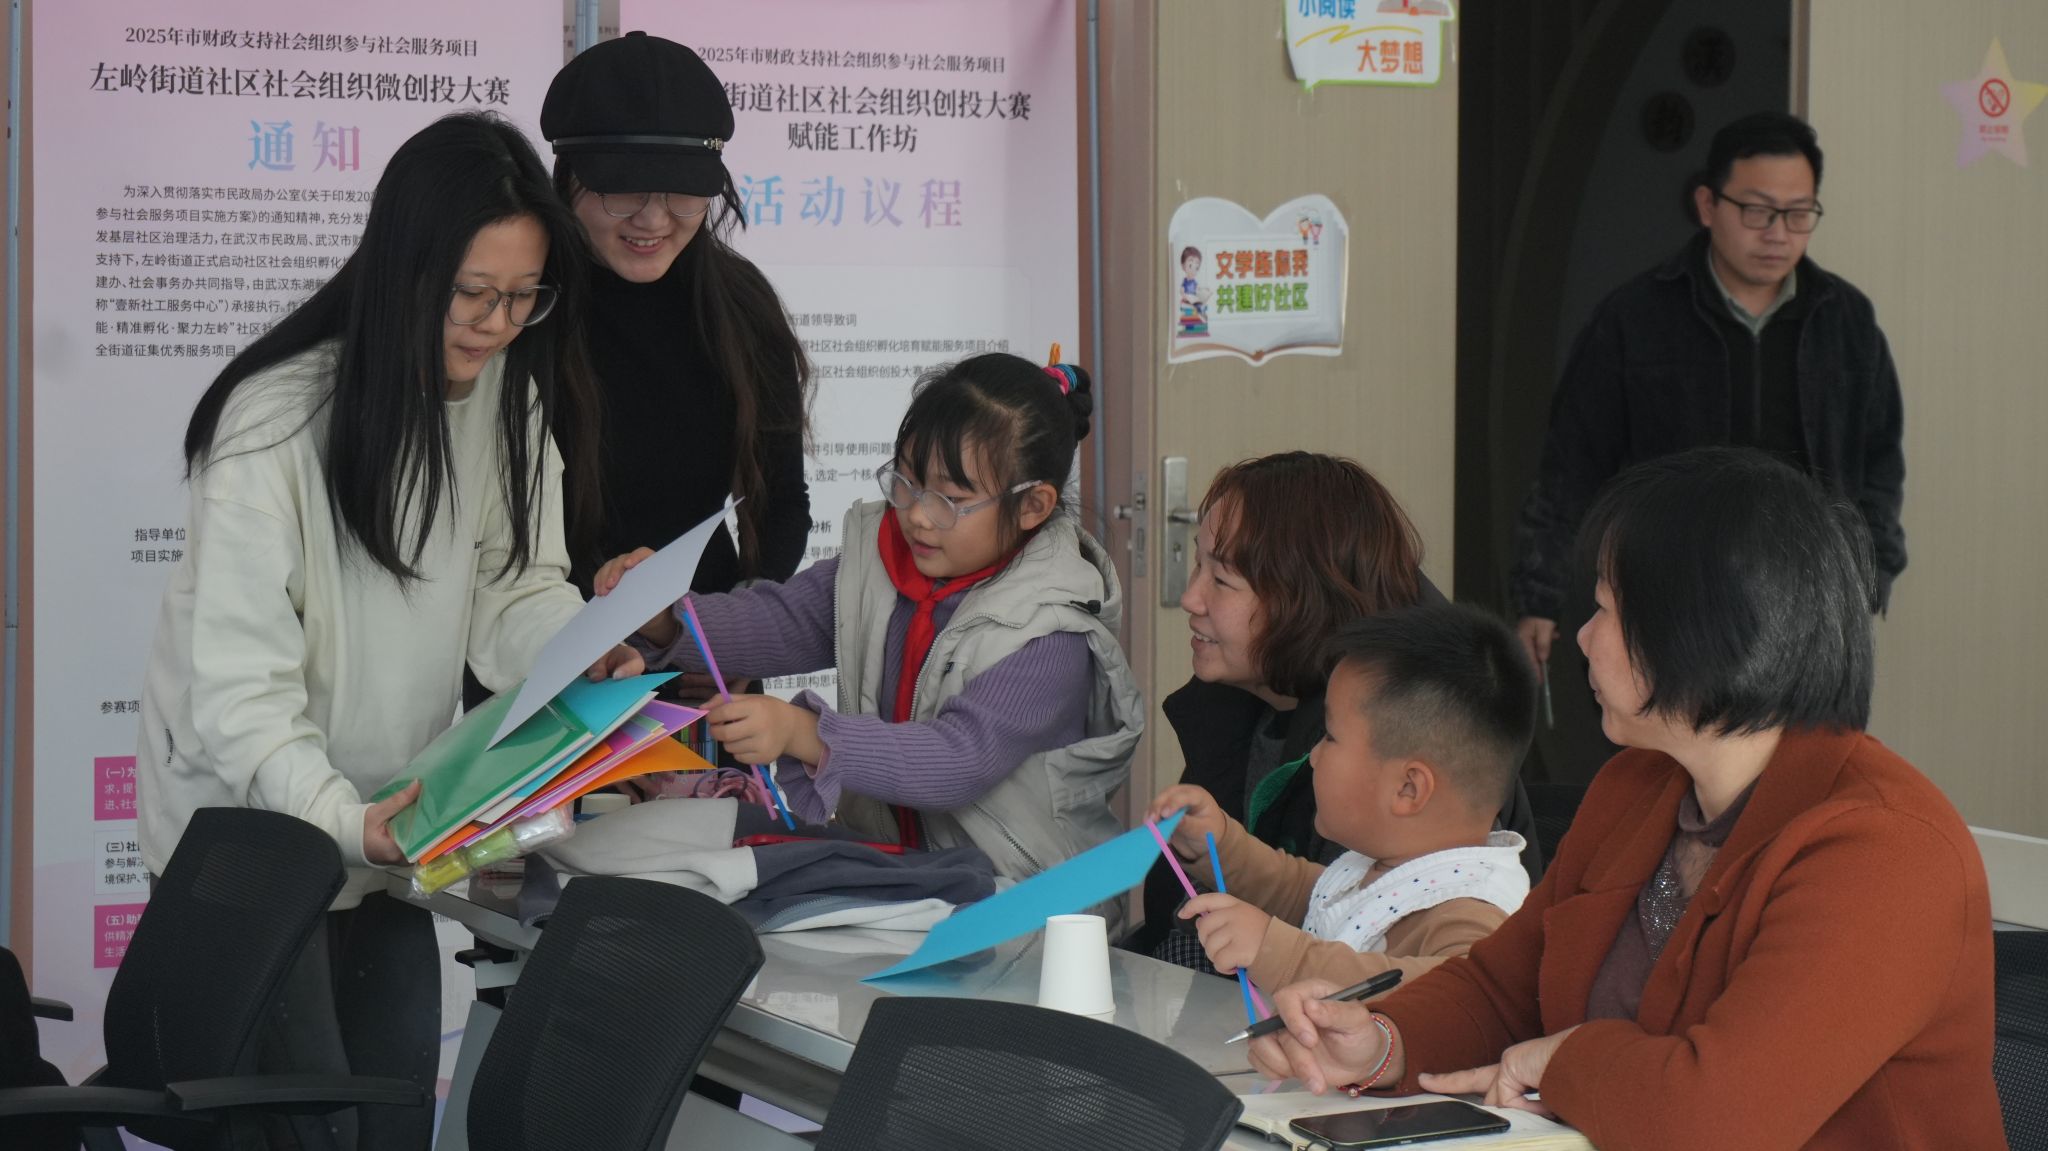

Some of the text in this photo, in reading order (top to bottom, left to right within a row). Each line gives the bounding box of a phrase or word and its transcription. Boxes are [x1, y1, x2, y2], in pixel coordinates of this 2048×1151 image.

[125, 26, 478, 58] 2025年市财政支持社会组织参与社会服务项目
[698, 46, 1006, 74] 2025年市财政支持社会组织参与社会服务项目
[1357, 39, 1424, 75] 大梦想
[89, 61, 511, 106] 左岭街道社区社会组织微创投大赛
[723, 81, 1033, 122] 街道社区社会组织创投大赛
[248, 118, 361, 173] 通知
[788, 120, 918, 153] 赋能工作坊
[739, 173, 963, 229] 活动议程
[95, 253, 349, 270] 支持下，左岭街道正式启动社区社会组织孵化
[95, 342, 236, 358] 全街道征集优秀服务项目
[134, 527, 186, 543] 指导单位
[130, 549, 184, 564] 项目实施
[100, 700, 141, 714] 参赛项
[104, 783, 137, 796] 求，提
[105, 840, 140, 853] （三）社
